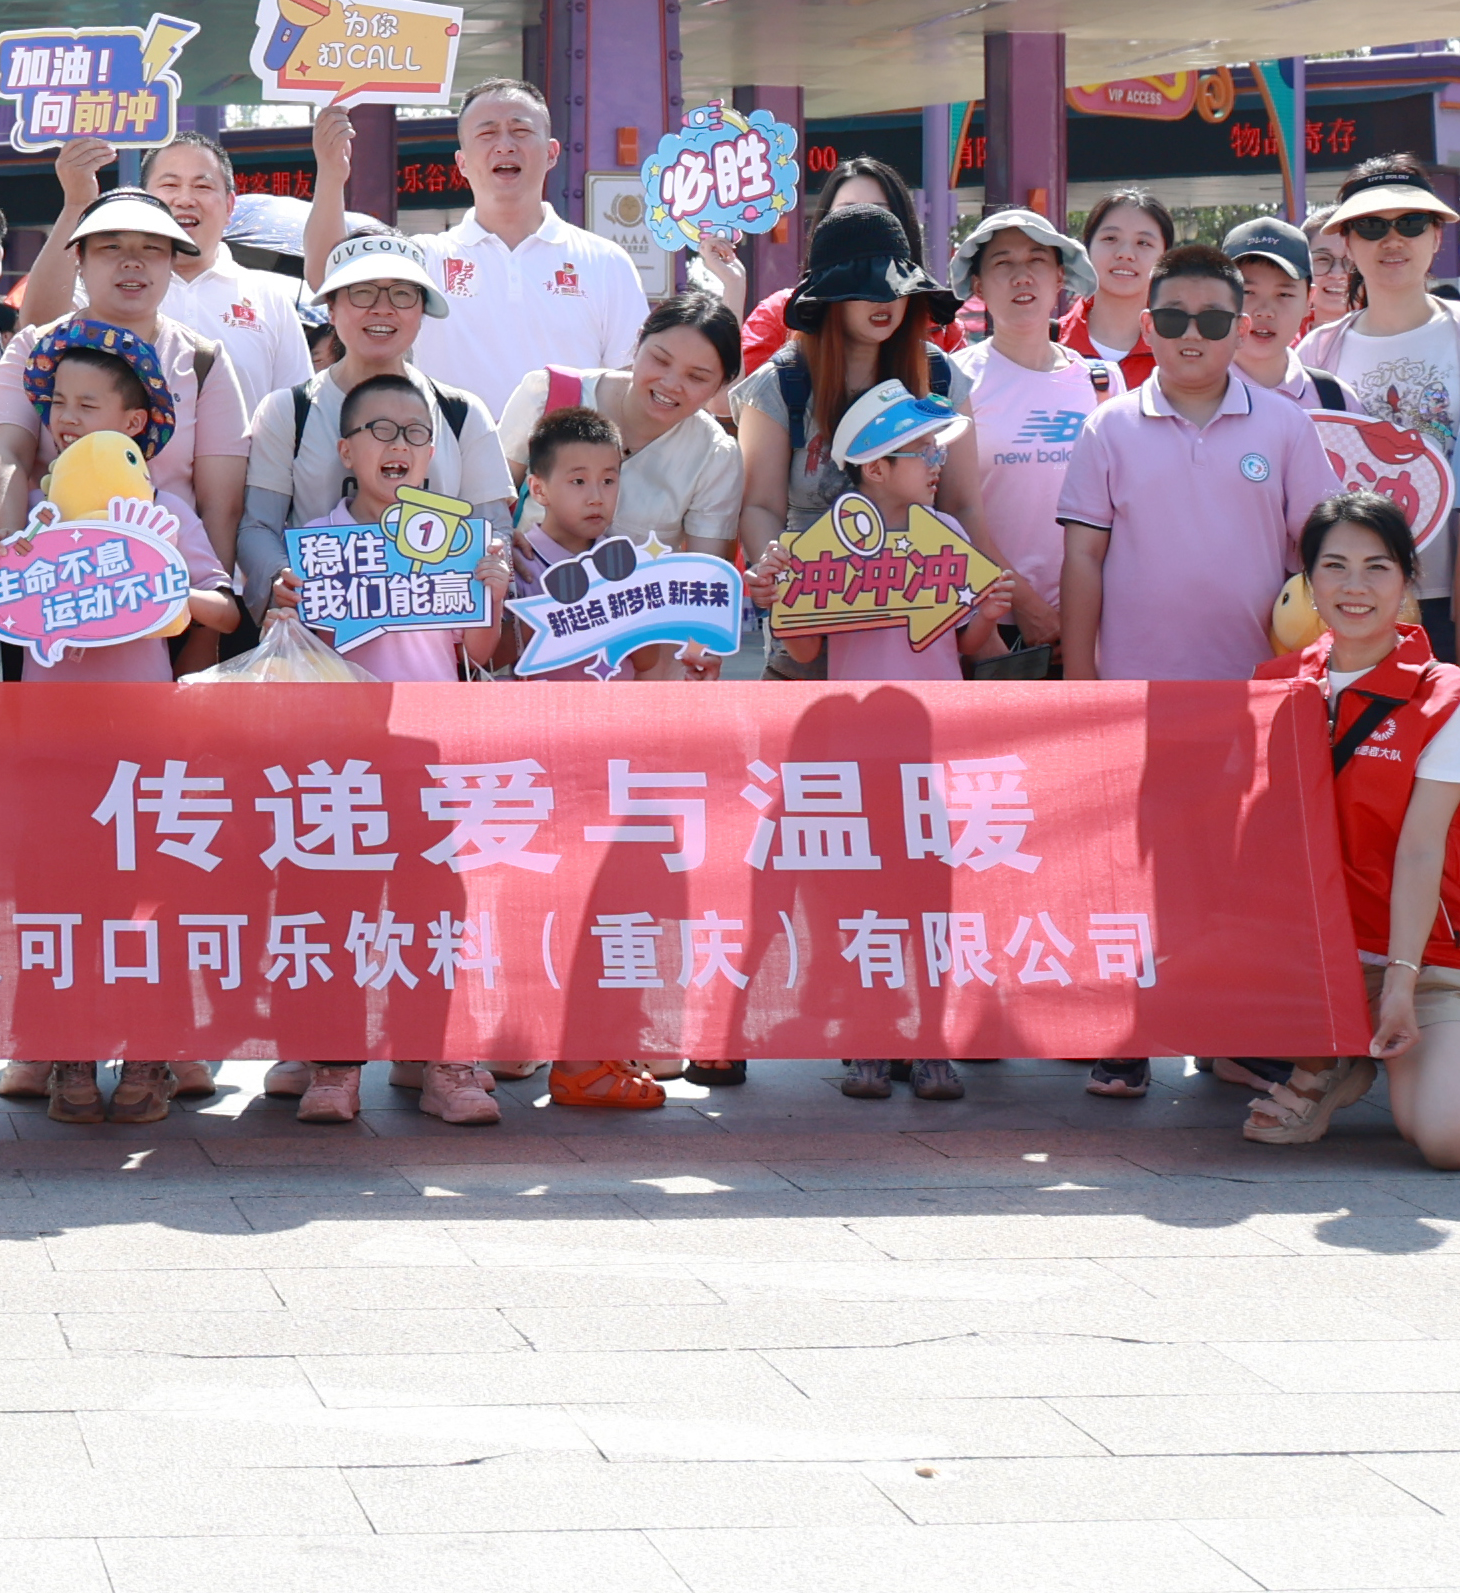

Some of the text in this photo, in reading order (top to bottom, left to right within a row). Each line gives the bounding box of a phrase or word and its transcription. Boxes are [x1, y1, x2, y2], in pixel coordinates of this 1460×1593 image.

[343, 11, 399, 39] 为你
[317, 41, 422, 73] 打CALL
[31, 90, 157, 134] 向前冲
[1108, 88, 1162, 106] VIP ACCESS
[663, 131, 774, 217] 必胜
[994, 451, 1032, 464] new
[301, 532, 384, 576] 稳住
[419, 520, 434, 547] 1
[42, 560, 190, 634] 运动不止
[303, 574, 474, 621] 我们能赢
[784, 544, 968, 610] 冲冲冲
[547, 580, 730, 638] 新起点 新梦想 新未来
[92, 754, 1043, 873] 传递爱与温暖
